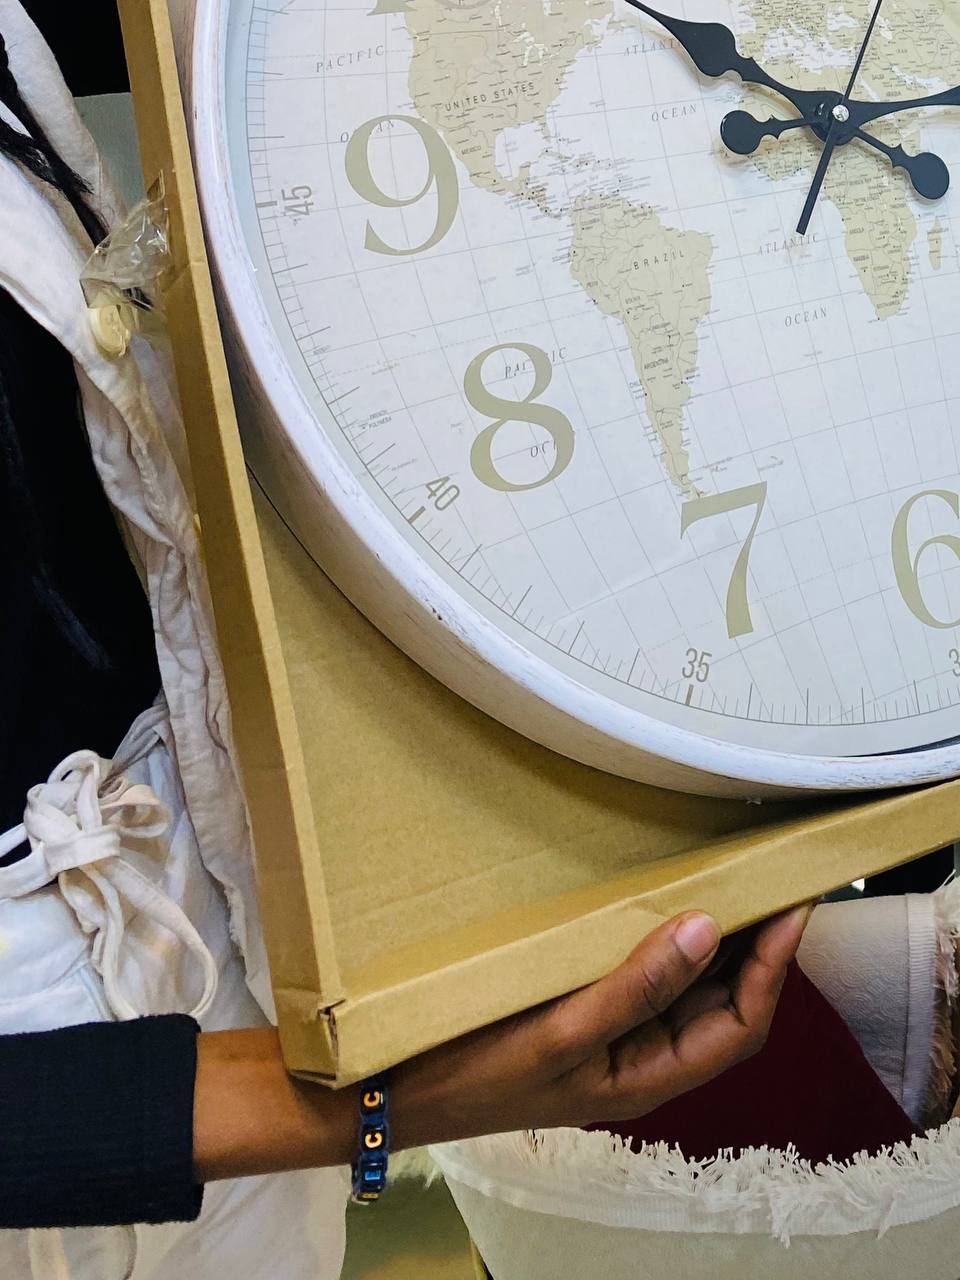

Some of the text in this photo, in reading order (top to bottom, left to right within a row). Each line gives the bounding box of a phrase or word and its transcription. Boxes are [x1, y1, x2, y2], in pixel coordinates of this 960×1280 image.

[315, 44, 385, 73] PACIFIC
[444, 81, 535, 112] UNITED STATES
[651, 104, 698, 122] OCEAN
[280, 184, 315, 218] 45
[343, 114, 460, 257] 9
[632, 249, 685, 271] BRAZIL
[757, 231, 820, 257] ATLANTIC
[784, 306, 828, 328] OCEAN
[462, 342, 576, 493] 8
[424, 474, 462, 513] 40
[680, 480, 768, 640] 7
[681, 647, 713, 684] 35
